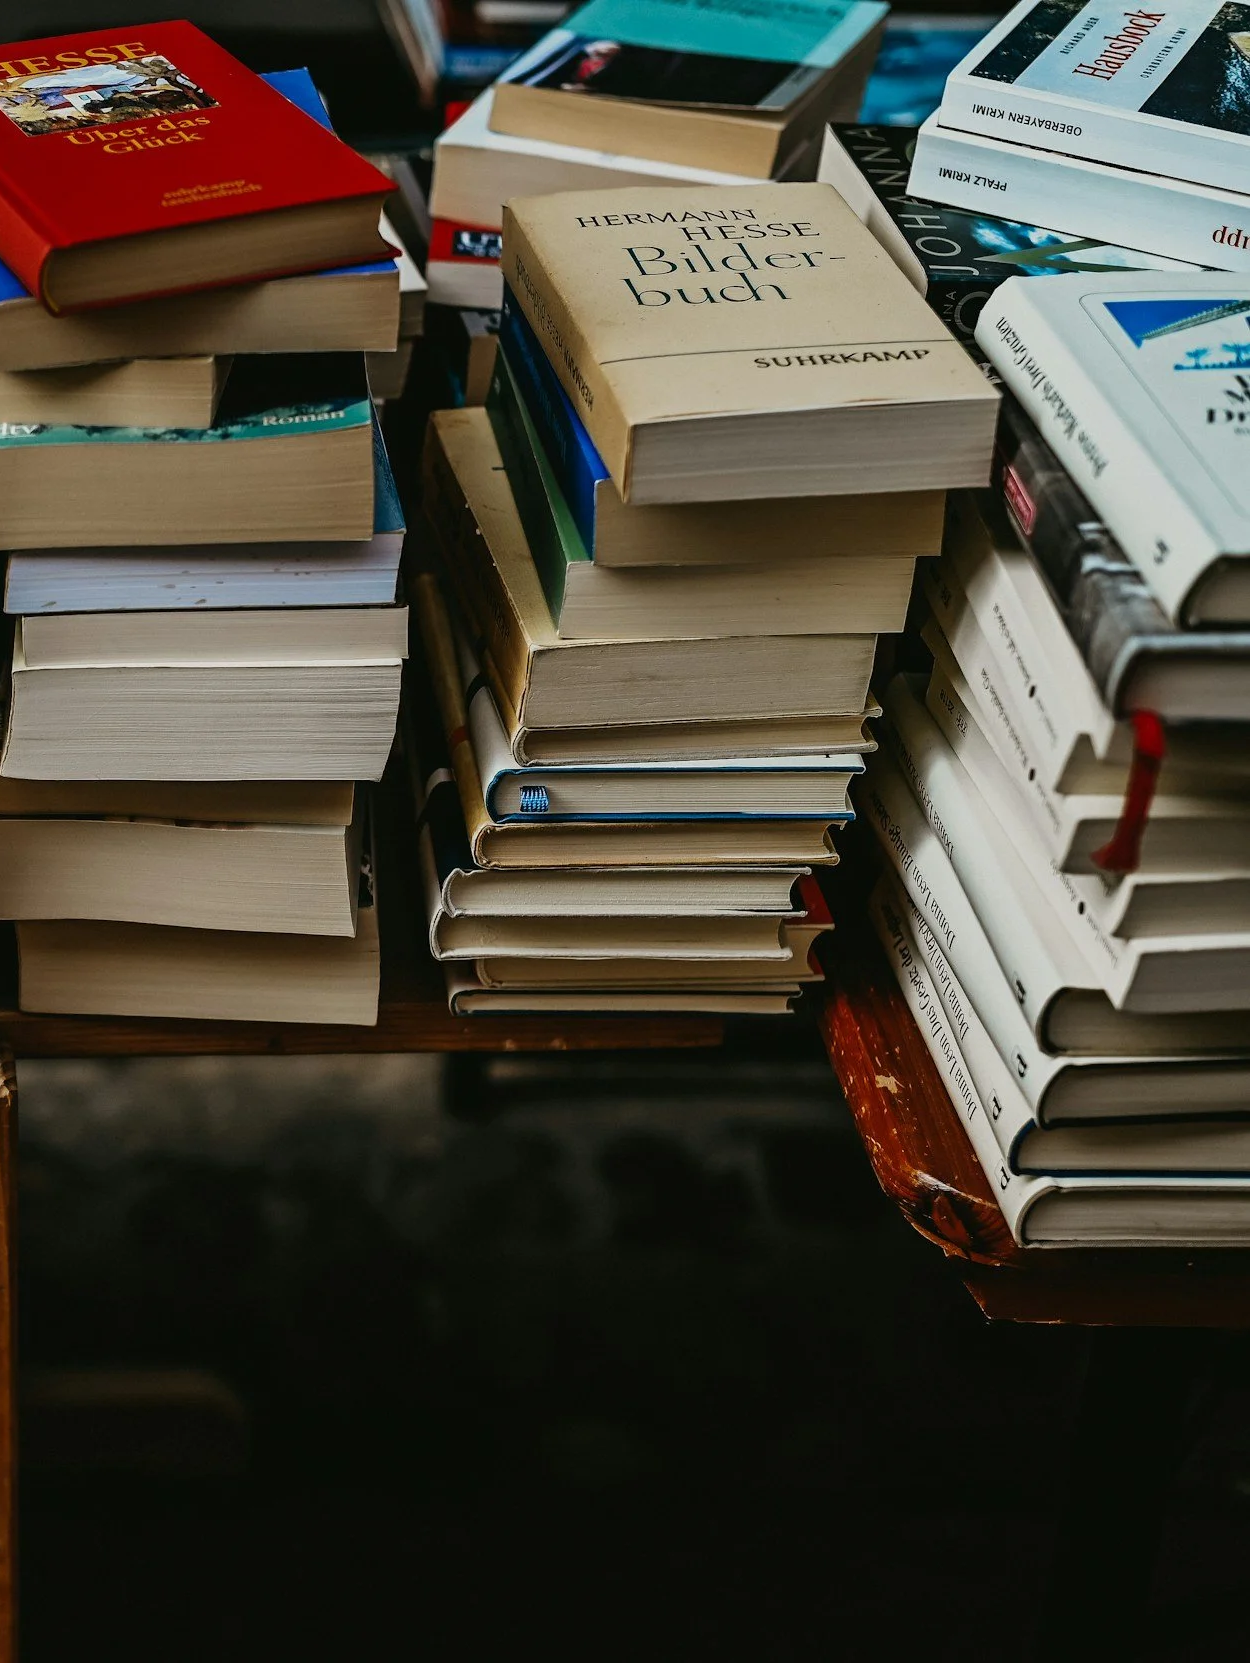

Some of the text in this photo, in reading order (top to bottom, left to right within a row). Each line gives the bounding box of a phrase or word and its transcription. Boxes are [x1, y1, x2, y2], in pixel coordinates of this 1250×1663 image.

[1060, 31, 1086, 55] RICHARD
[1071, 9, 1166, 81] Hausbock
[64, 115, 211, 146] Über das
[972, 103, 1083, 137] OBERBAYERN KRIMI
[103, 130, 206, 155] Glück
[939, 167, 1008, 192] PFALZ KRIMI
[575, 209, 758, 228] HERMANN
[678, 222, 820, 241] HESSE
[622, 242, 846, 277] Bilder-
[620, 272, 793, 307] buch
[754, 350, 931, 370] SUHRKAMP
[262, 409, 345, 427] Roman
[912, 863, 932, 907] Leon
[929, 897, 957, 953] Donna
[898, 945, 912, 969] der
[909, 965, 929, 1008] Gesetz
[937, 960, 952, 997] Leon
[927, 1006, 943, 1039] Das
[948, 988, 970, 1041] Donna
[940, 1033, 958, 1076] Leon
[954, 1067, 978, 1122] Donna
